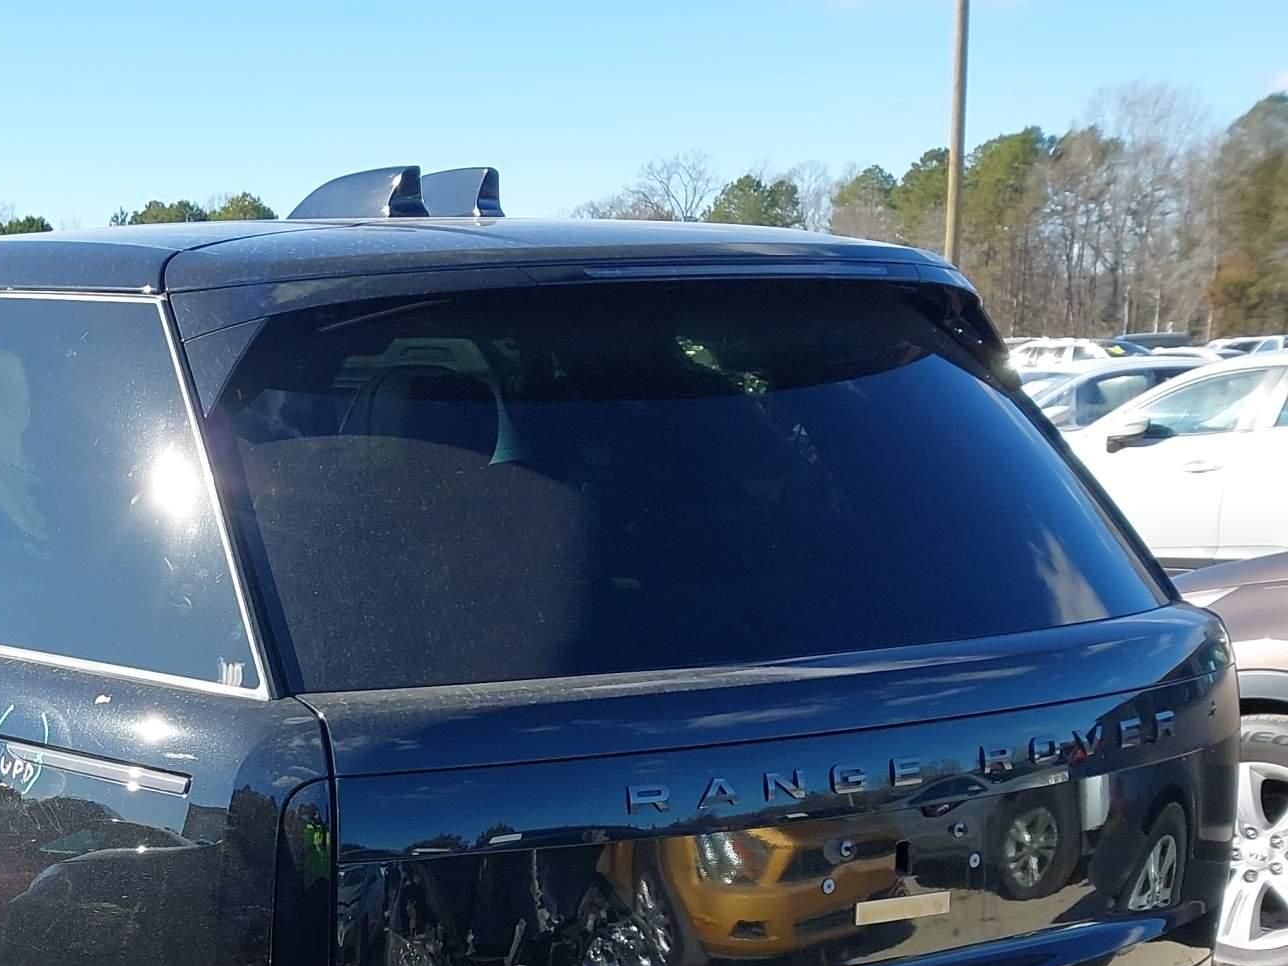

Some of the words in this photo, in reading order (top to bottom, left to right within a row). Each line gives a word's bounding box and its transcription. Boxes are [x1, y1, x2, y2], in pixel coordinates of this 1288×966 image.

[0, 755, 34, 783] UPD
[626, 757, 923, 816] RANGE
[978, 710, 1175, 774] ROVER
